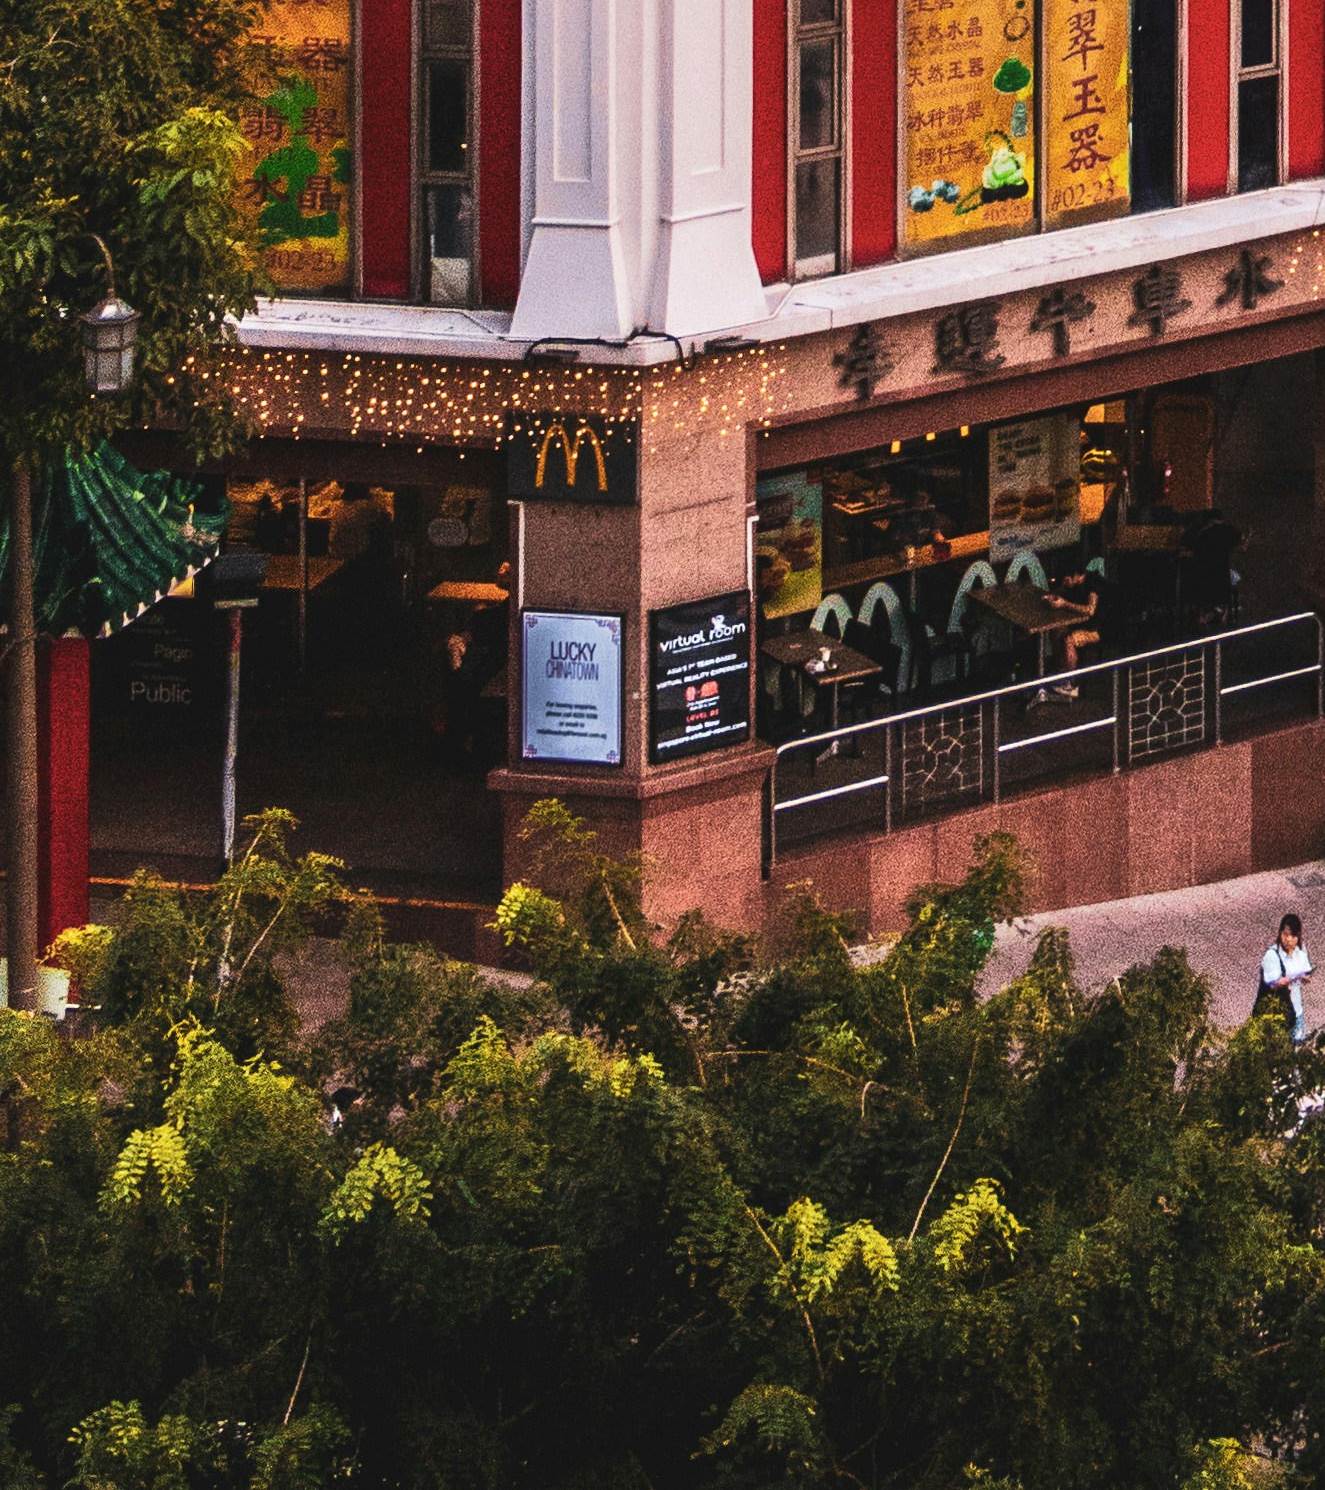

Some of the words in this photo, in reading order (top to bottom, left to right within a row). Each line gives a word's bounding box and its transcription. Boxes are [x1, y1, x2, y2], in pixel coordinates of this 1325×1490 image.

[244, 174, 342, 212] 水晶
[1051, 177, 1118, 211] #02-23
[550, 640, 597, 662] LUCKY
[659, 630, 705, 653] virtual
[709, 622, 746, 641] room
[545, 660, 600, 682] CHINATOWN
[130, 681, 193, 704] Public
